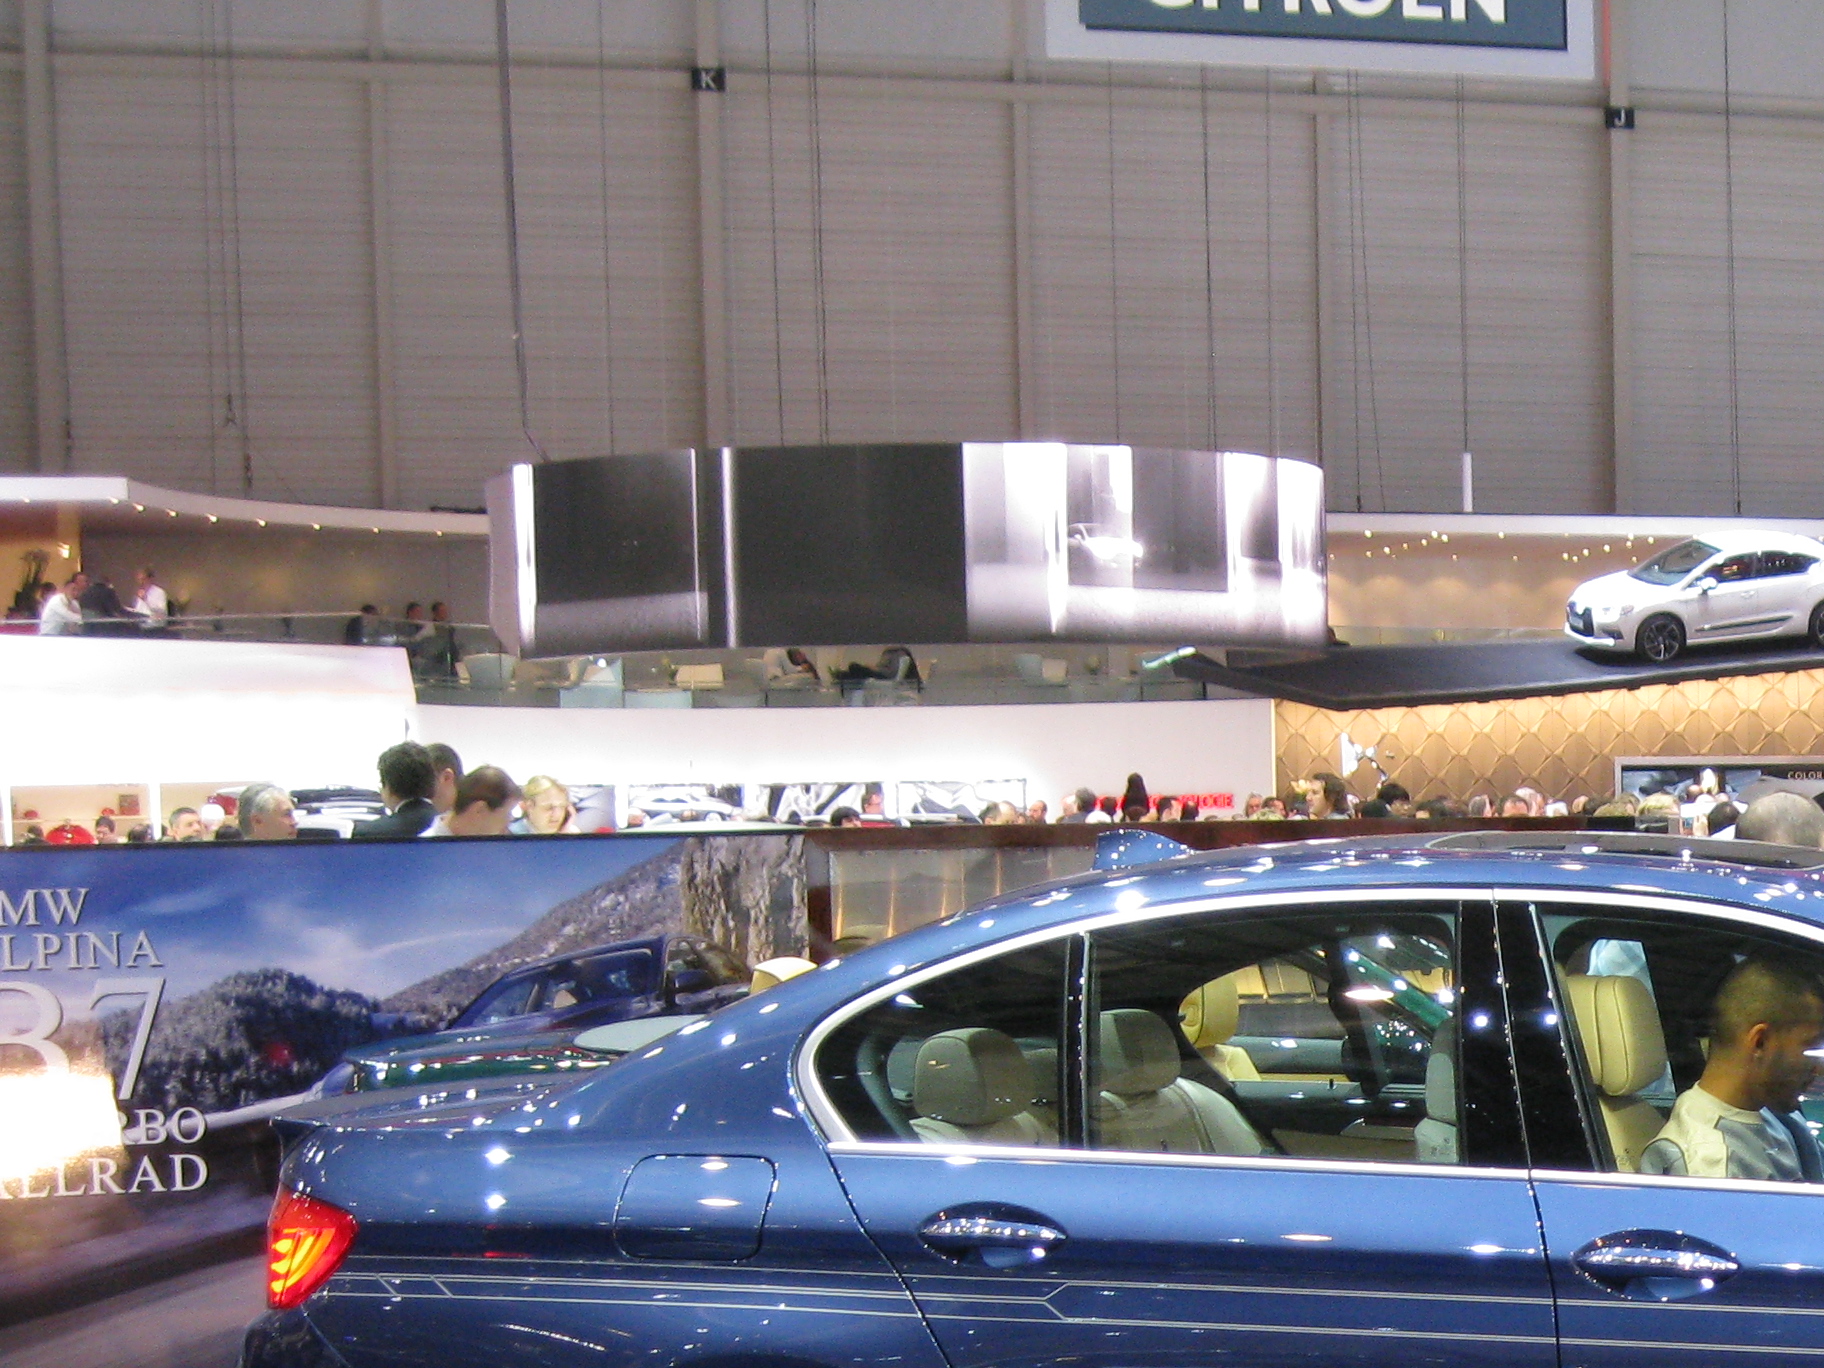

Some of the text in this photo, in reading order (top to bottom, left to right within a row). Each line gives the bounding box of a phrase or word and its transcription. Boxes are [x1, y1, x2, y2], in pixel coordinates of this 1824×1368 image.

[1613, 108, 1626, 127] J
[0, 887, 90, 927] MW
[0, 930, 165, 972] LPINA
